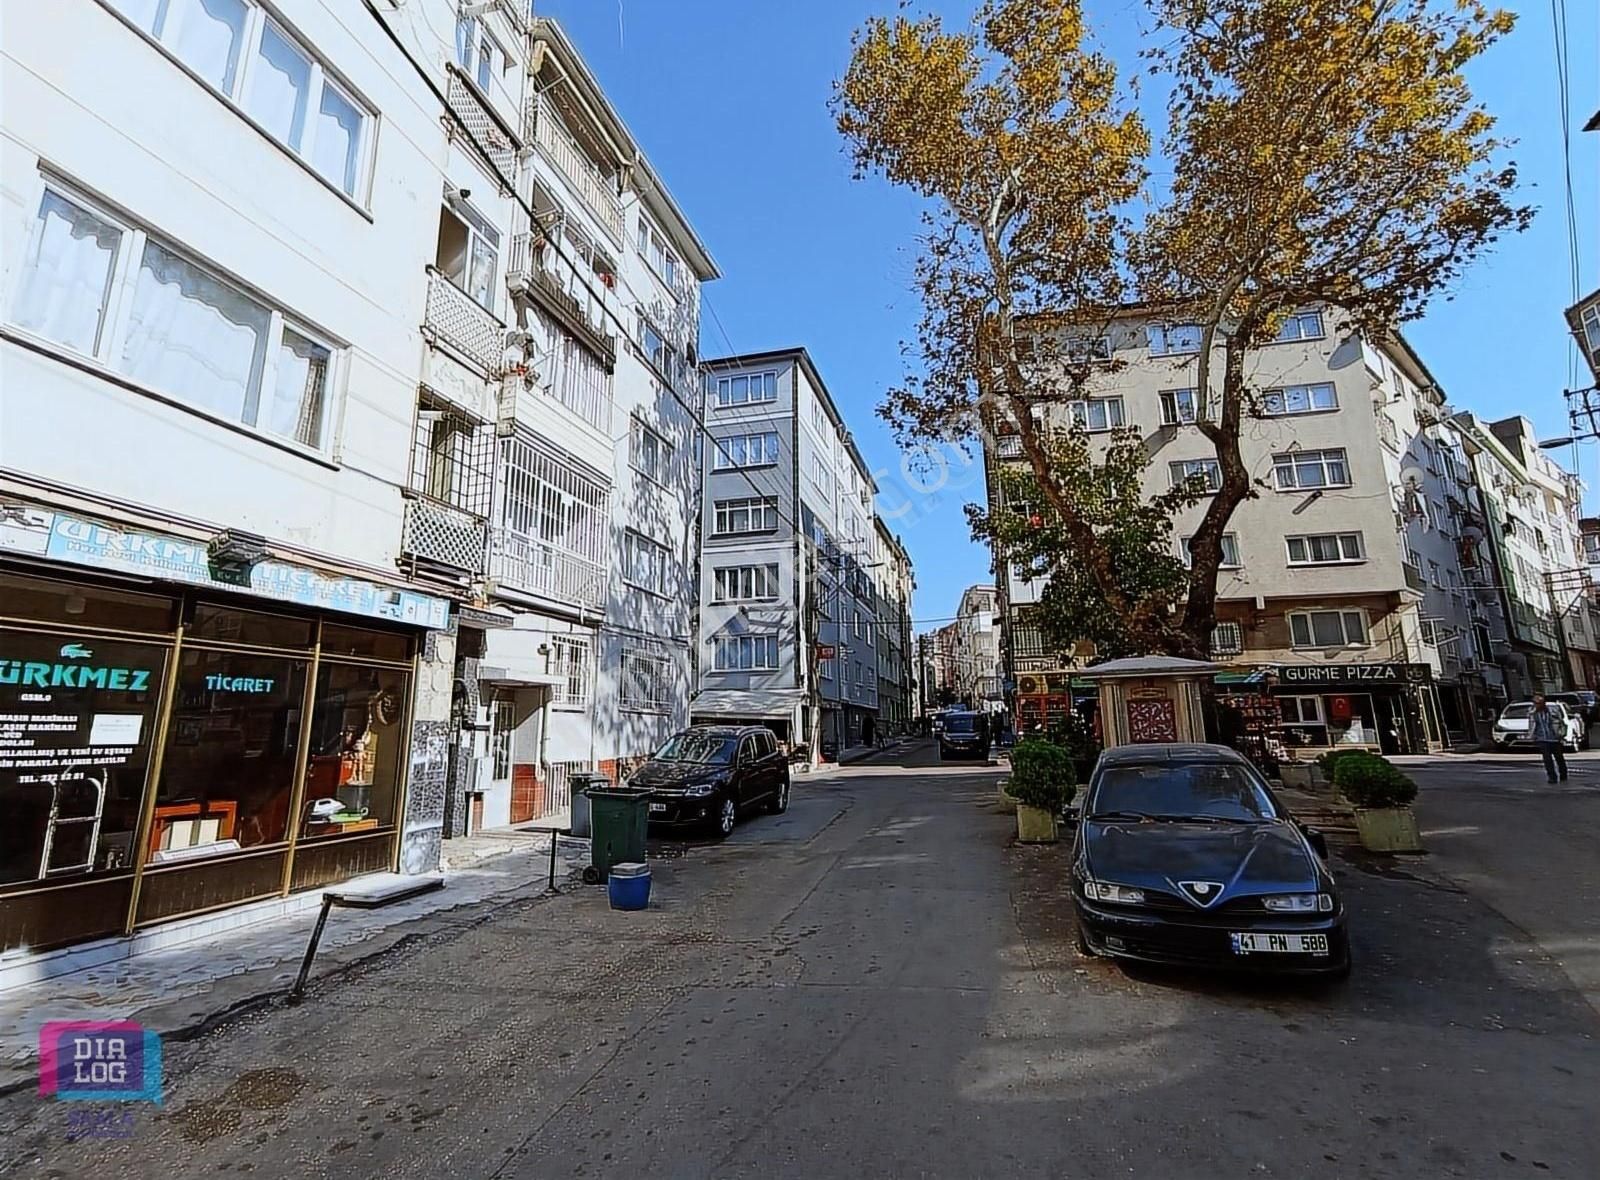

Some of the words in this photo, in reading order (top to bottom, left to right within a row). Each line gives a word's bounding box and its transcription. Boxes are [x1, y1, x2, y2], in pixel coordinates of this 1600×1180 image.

[1286, 667, 1340, 680] GURME
[1347, 666, 1396, 679] PIZZA
[205, 673, 275, 693] TİCARET
[1240, 934, 1256, 949] 41
[1269, 935, 1288, 950] PN
[1301, 936, 1327, 951] 588
